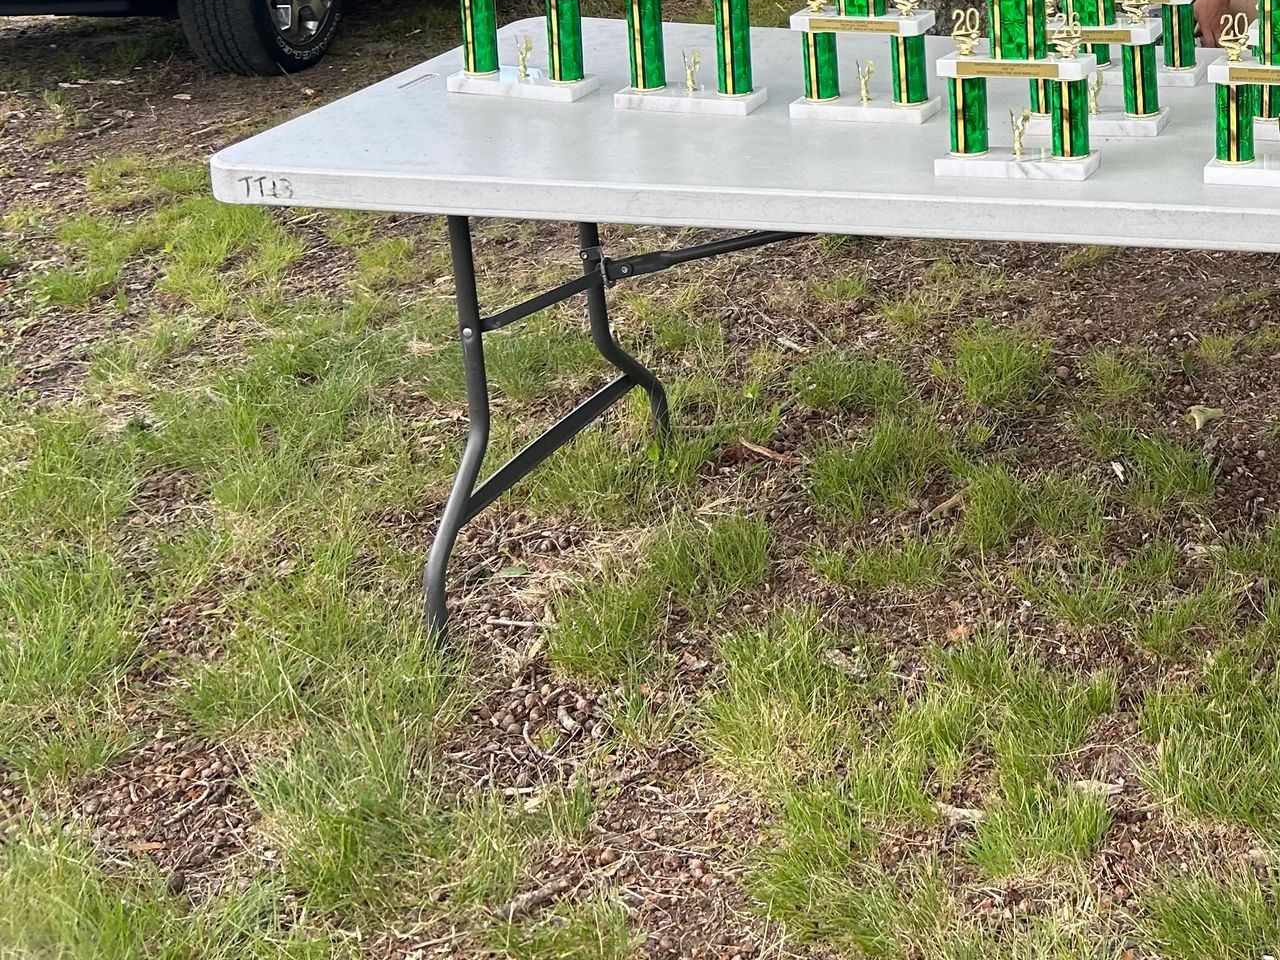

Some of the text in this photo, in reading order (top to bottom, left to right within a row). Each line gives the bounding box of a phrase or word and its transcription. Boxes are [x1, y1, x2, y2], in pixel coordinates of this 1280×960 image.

[952, 8, 980, 33] 20
[1052, 12, 1082, 37] 26
[1220, 12, 1248, 39] 20
